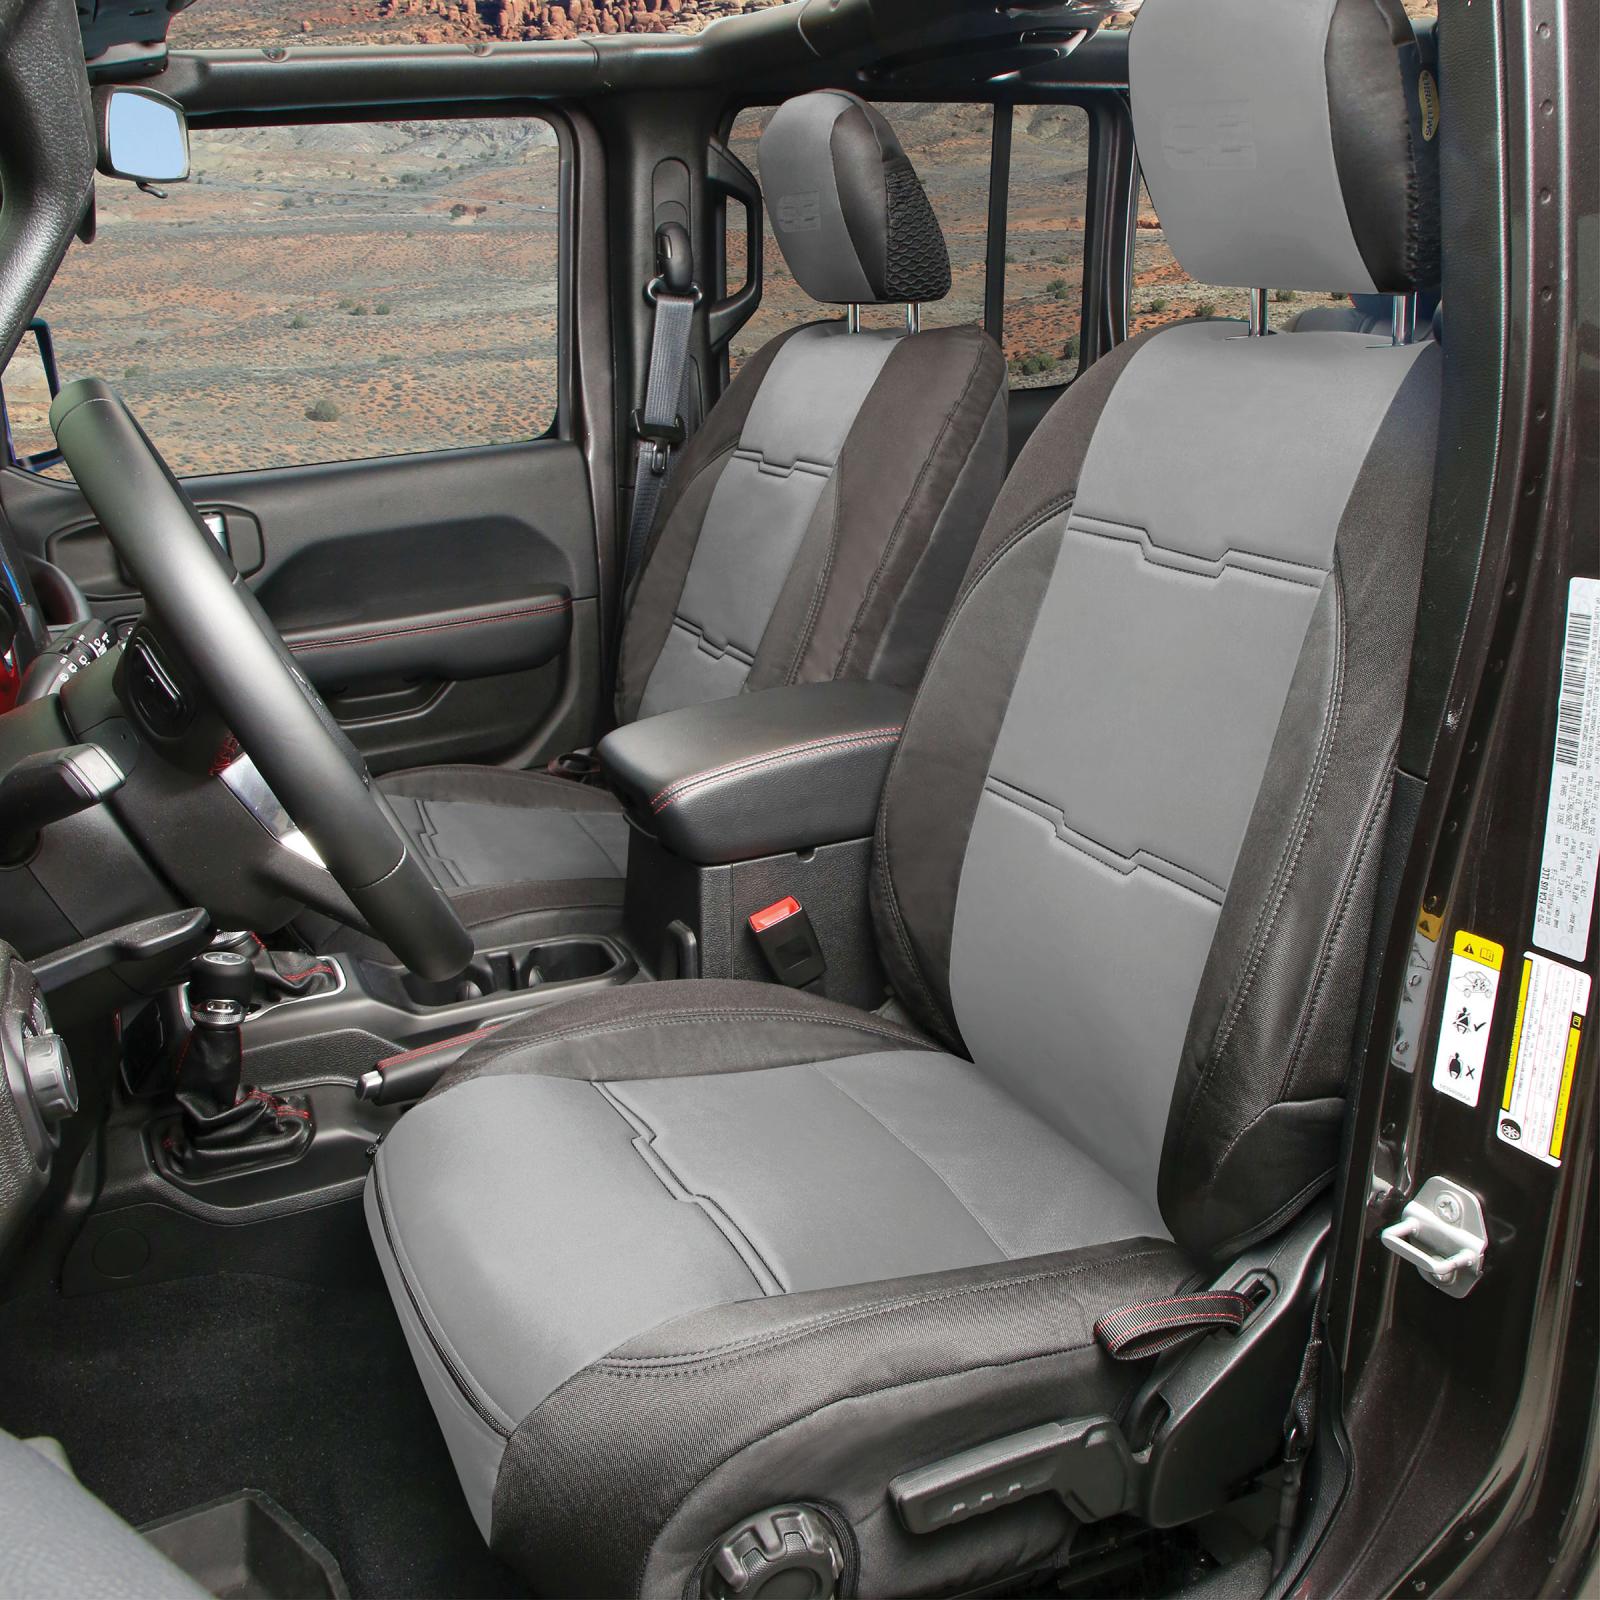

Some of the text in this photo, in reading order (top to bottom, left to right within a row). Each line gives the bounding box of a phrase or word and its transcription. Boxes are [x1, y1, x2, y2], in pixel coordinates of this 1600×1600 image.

[1541, 867, 1550, 879] LLC
[1540, 880, 1548, 890] US
[1538, 891, 1547, 904] FCA
